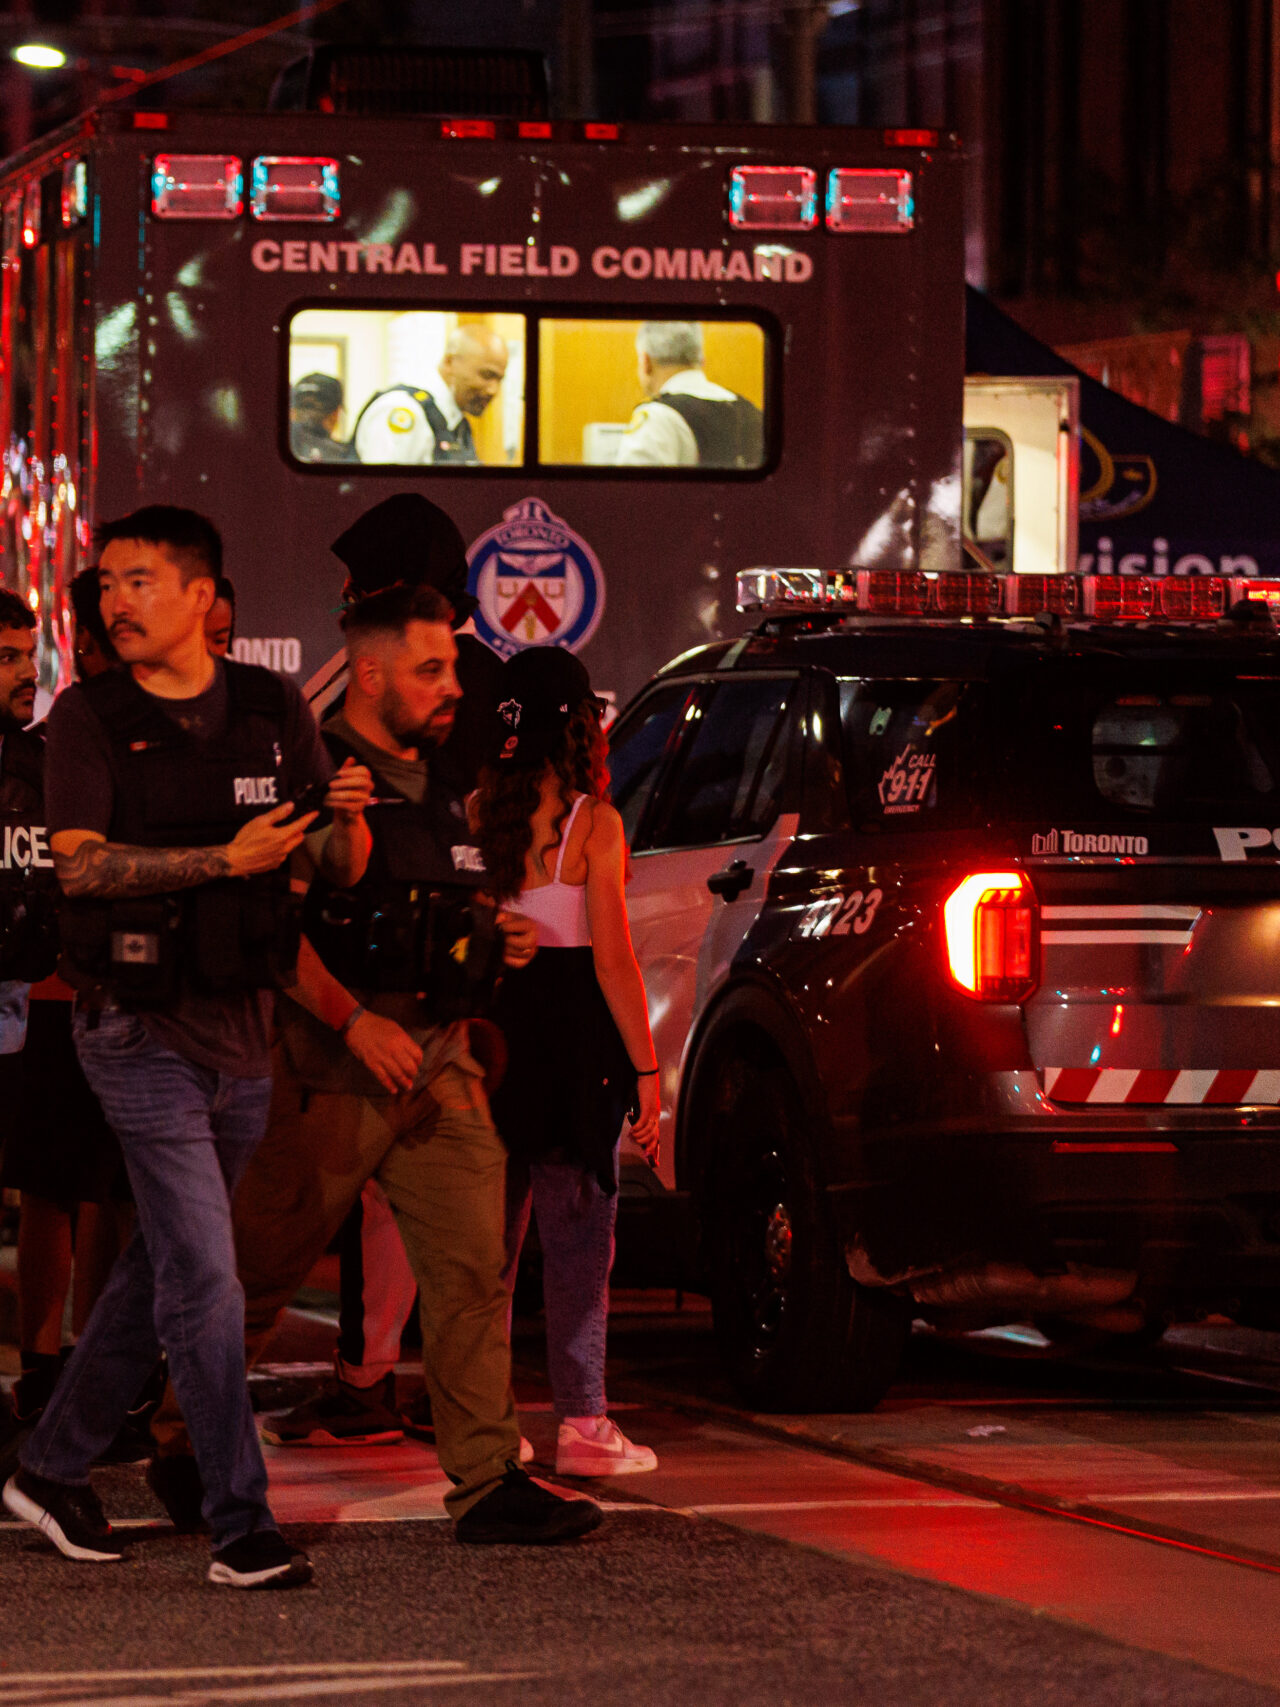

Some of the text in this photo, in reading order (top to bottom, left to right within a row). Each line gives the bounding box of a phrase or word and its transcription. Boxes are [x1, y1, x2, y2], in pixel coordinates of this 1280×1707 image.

[251, 239, 813, 283] CENTRAL FIELD COMMAND
[225, 637, 301, 674] ONTO
[908, 753, 936, 768] CALL
[234, 776, 279, 805] POLICE
[887, 768, 933, 802] 9-1-1
[1060, 830, 1149, 855] TORONTO
[799, 888, 883, 938] 4223
